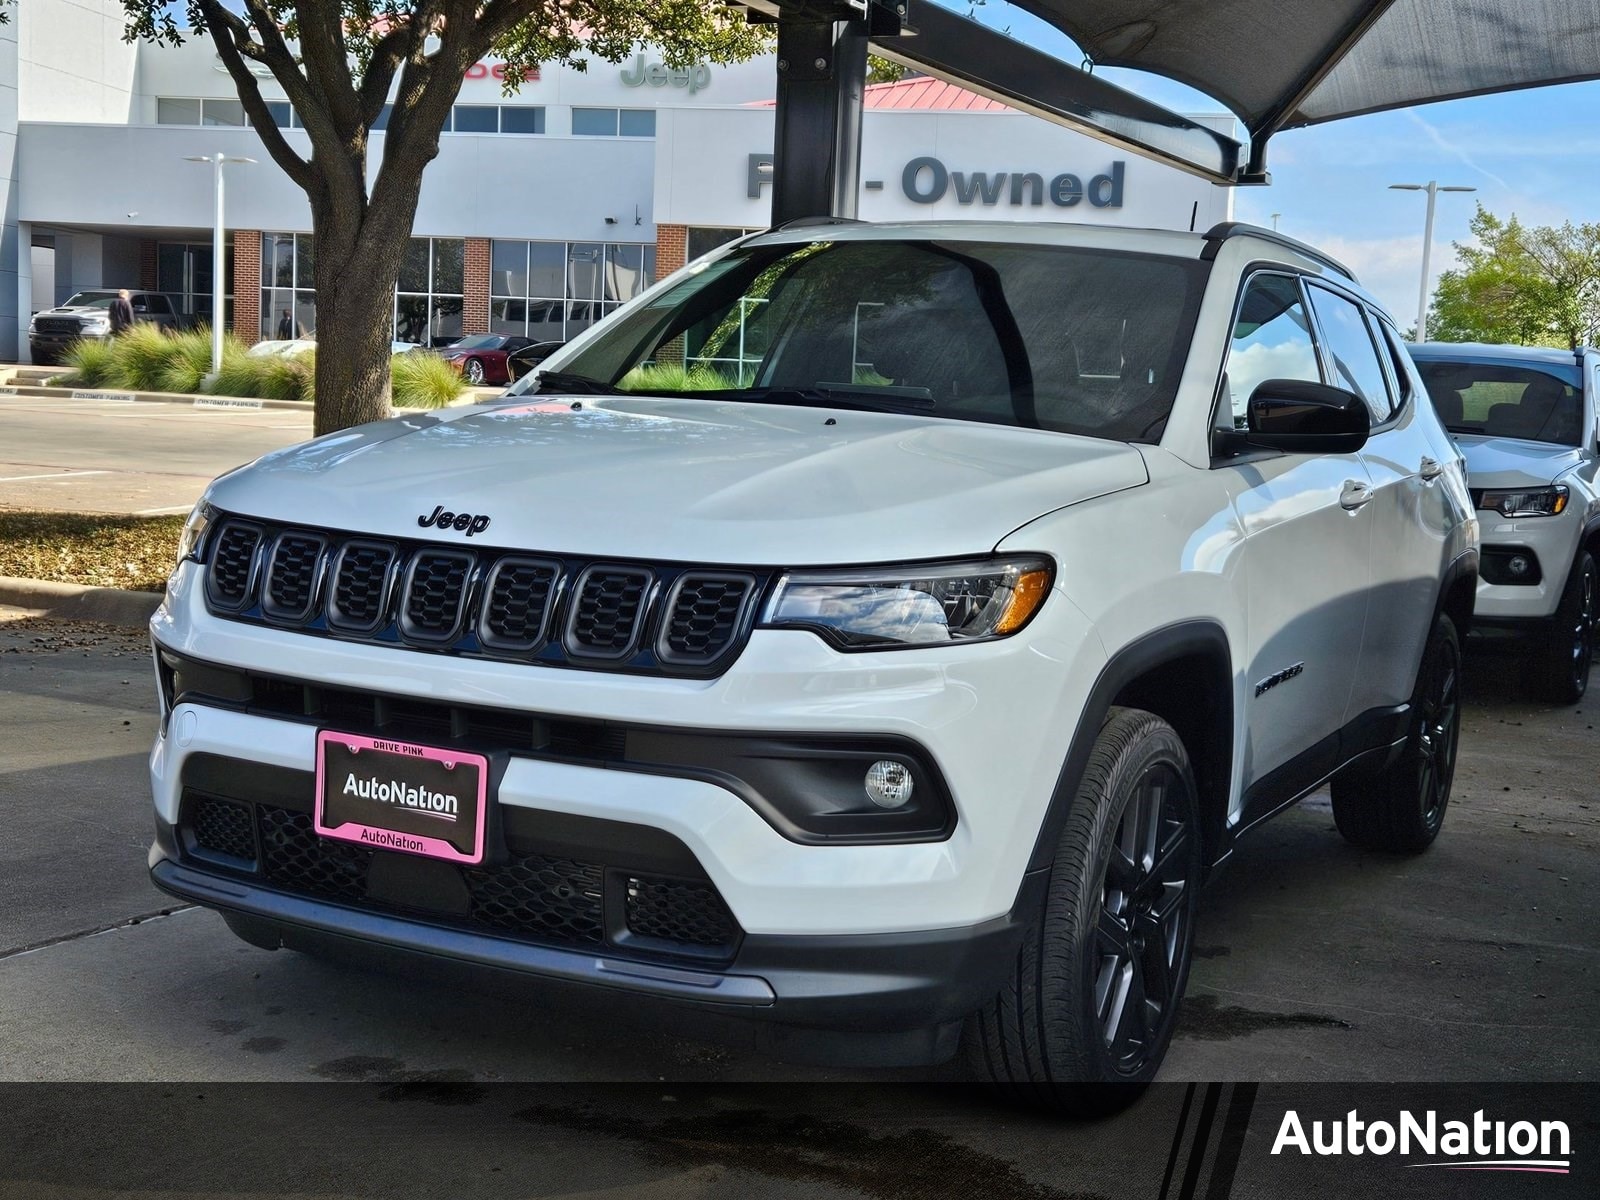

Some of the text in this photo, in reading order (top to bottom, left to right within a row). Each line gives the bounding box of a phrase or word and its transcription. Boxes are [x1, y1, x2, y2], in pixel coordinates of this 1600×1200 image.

[620, 53, 712, 95] Jeep
[901, 156, 1126, 209] Owned
[418, 505, 491, 537] Jeep
[373, 740, 424, 756] DRIVE PINK
[342, 773, 458, 813] AutoNation
